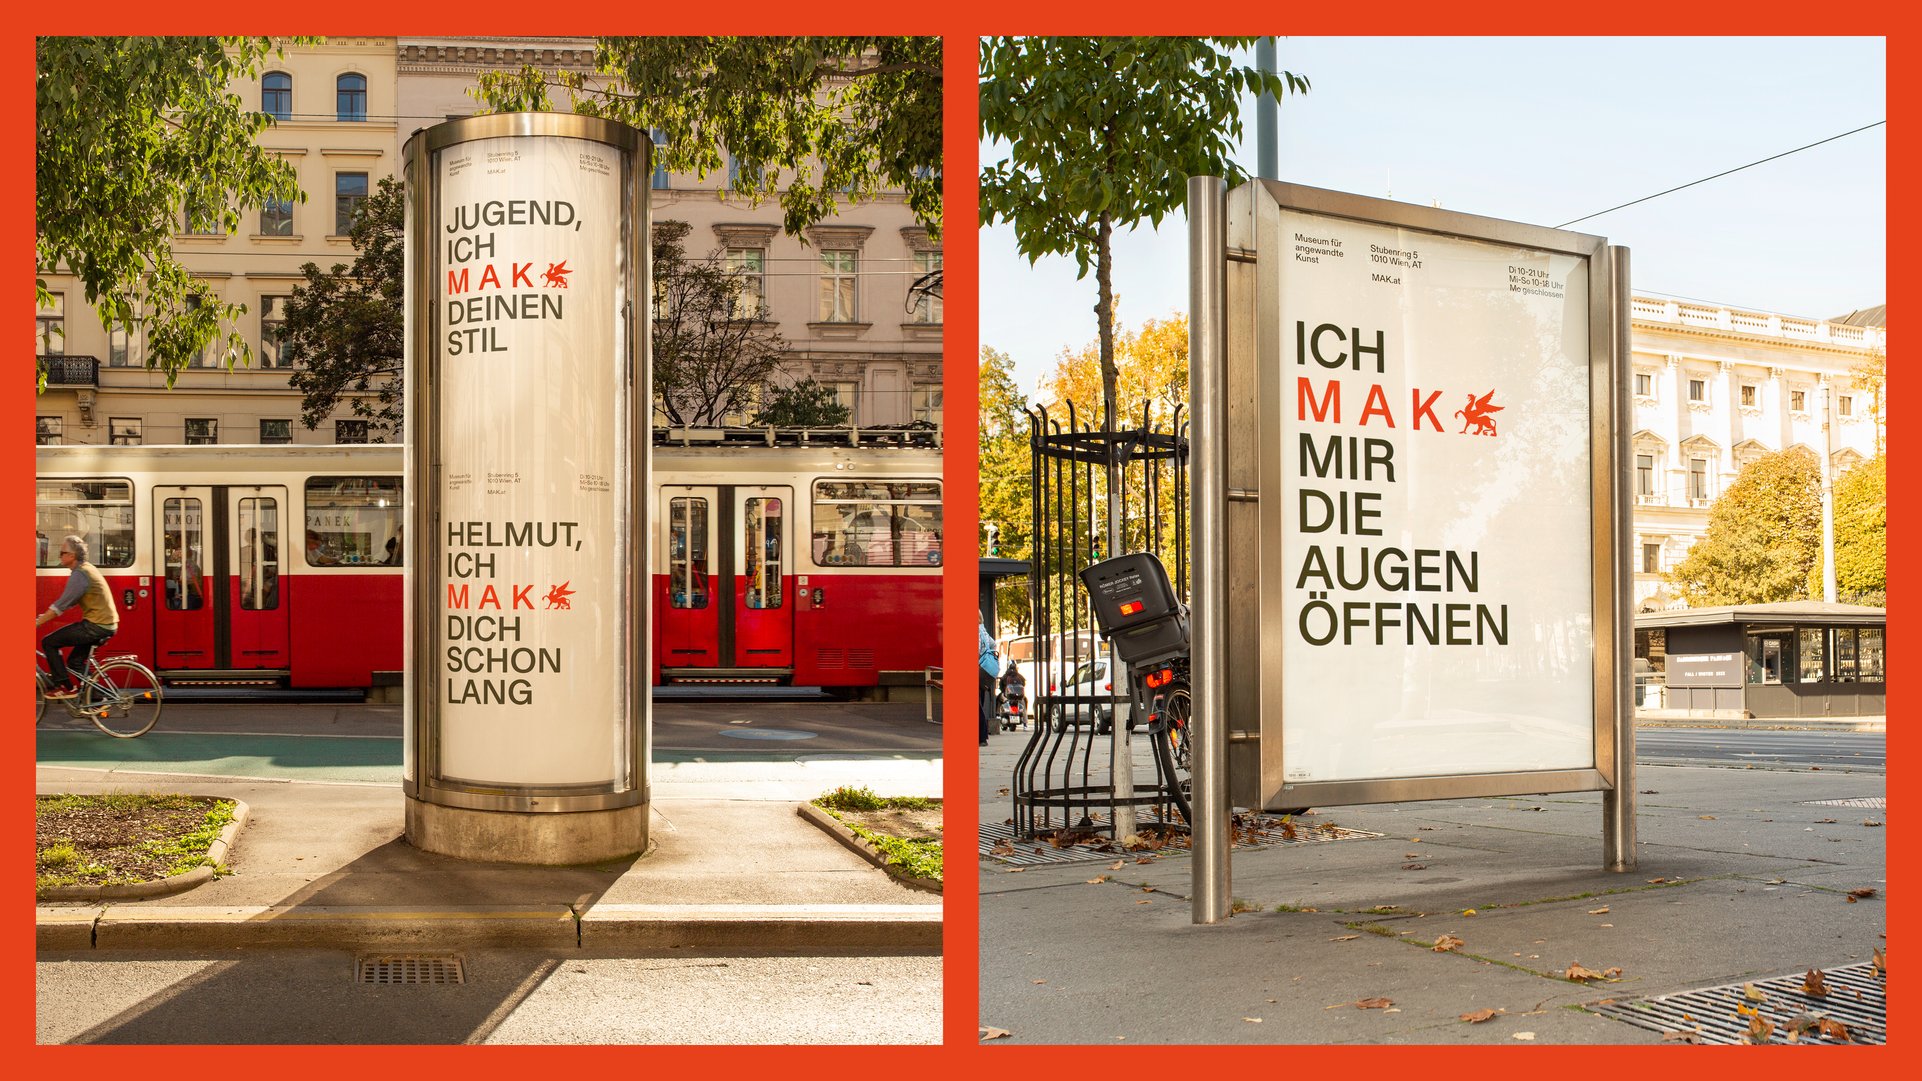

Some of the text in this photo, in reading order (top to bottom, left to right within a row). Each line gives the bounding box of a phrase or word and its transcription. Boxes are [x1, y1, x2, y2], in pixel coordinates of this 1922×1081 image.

[446, 200, 582, 233] JUGEND,
[448, 232, 494, 264] ICH
[1295, 233, 1342, 247] Museum für
[1295, 244, 1344, 257] angewandte
[1370, 244, 1418, 260] Stubenring 5
[1296, 253, 1319, 264] Kunst
[1371, 254, 1387, 264] 1010
[1509, 266, 1549, 278] Di 10-21 Uhr
[1372, 274, 1401, 285] MAK.at
[1510, 275, 1564, 290] Mi-So 10-18 Uhr
[1510, 284, 1564, 298] Mo geschlossen
[448, 294, 562, 325] DEINEN
[448, 327, 508, 356] STIL
[1297, 320, 1384, 373] ICH
[1297, 376, 1444, 432] MAK
[1299, 432, 1396, 482] MIR
[1299, 488, 1383, 536] DIE
[448, 522, 582, 551] HELMUT,
[448, 552, 495, 578] ICH
[1296, 545, 1478, 593] AUGEN
[448, 615, 520, 641] DICH
[1299, 591, 1508, 646] ÖFFNEN
[447, 646, 560, 673] SCHON
[448, 678, 532, 705] LANG
